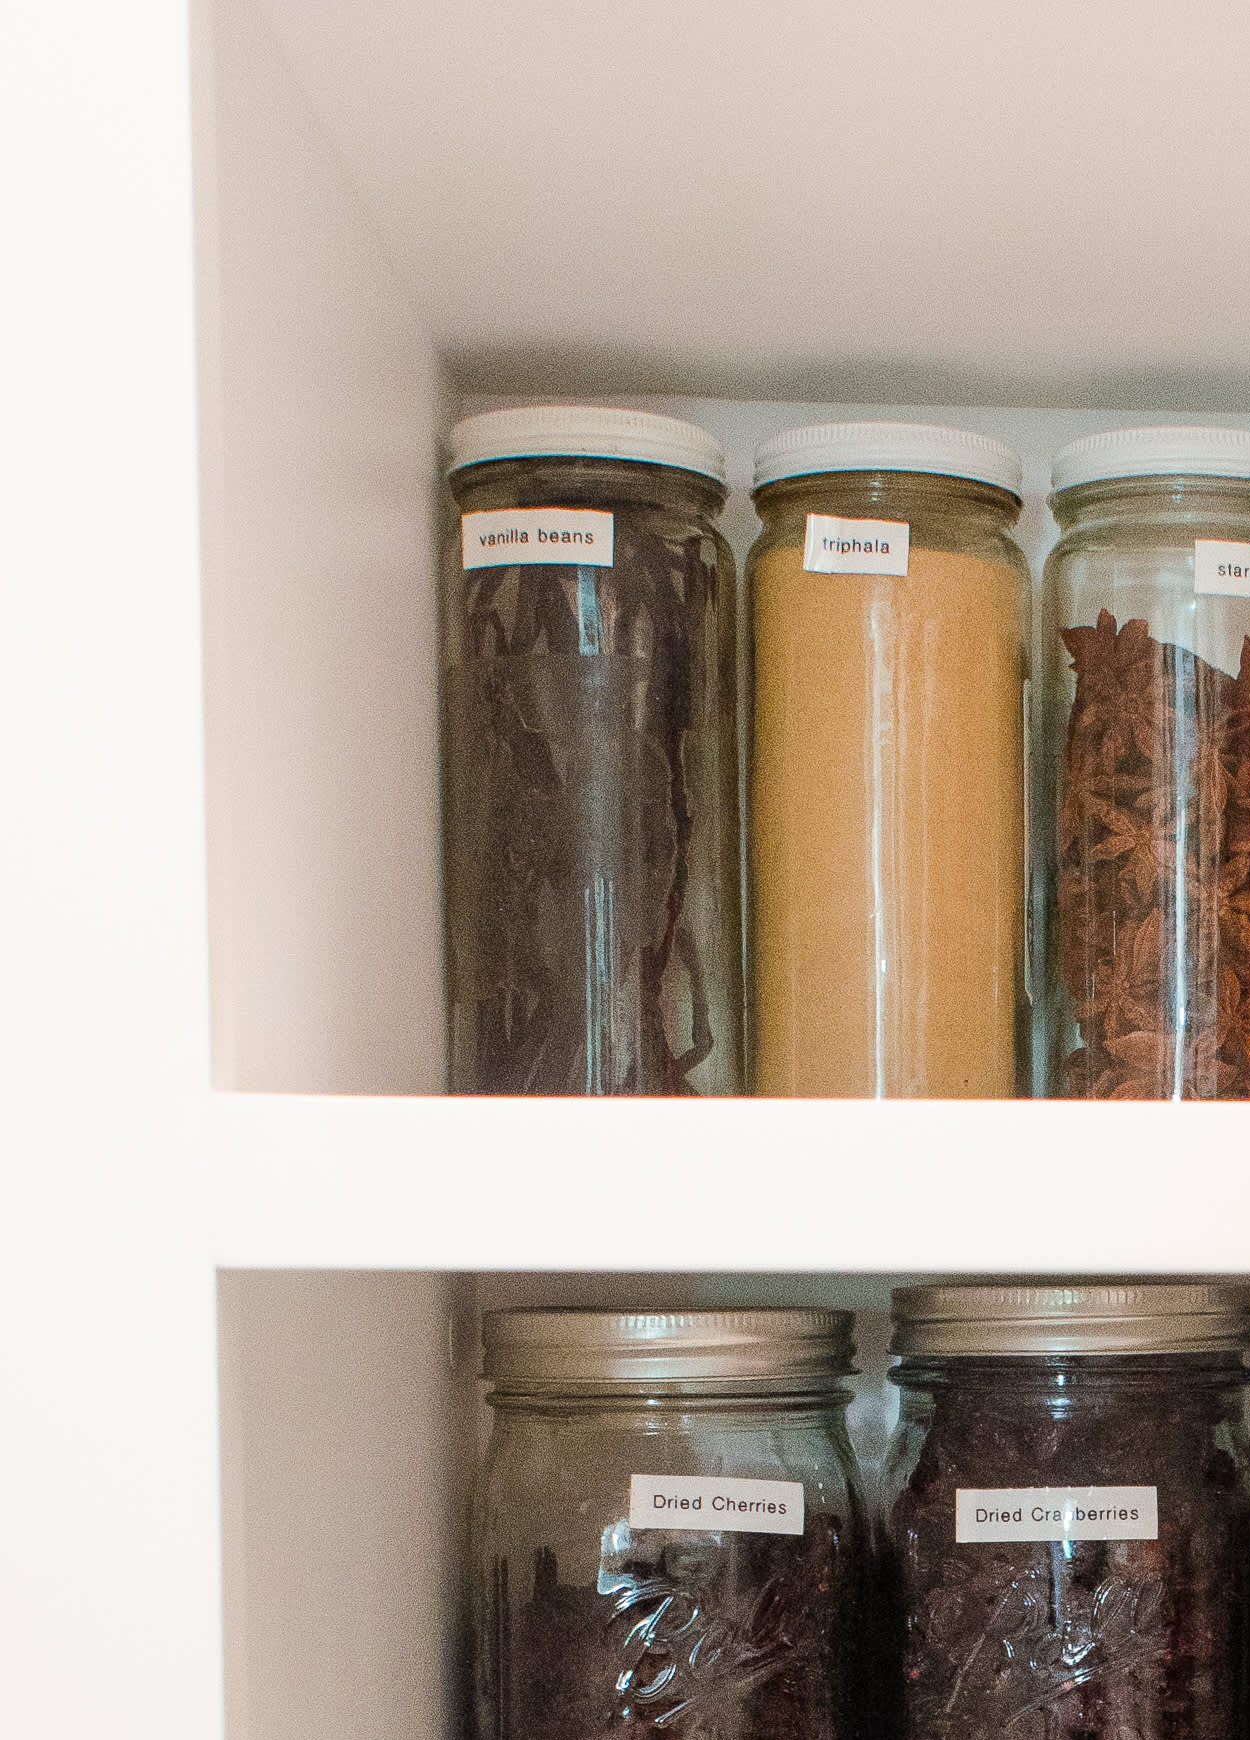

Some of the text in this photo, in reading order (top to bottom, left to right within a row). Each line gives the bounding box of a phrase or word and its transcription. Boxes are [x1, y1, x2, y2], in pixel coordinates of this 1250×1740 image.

[479, 528, 594, 547] vanilla beans
[822, 537, 890, 555] triphala
[1217, 563, 1250, 578] star
[653, 1494, 788, 1515] Dried Cherries
[975, 1506, 1140, 1523] Dried Cranberries
